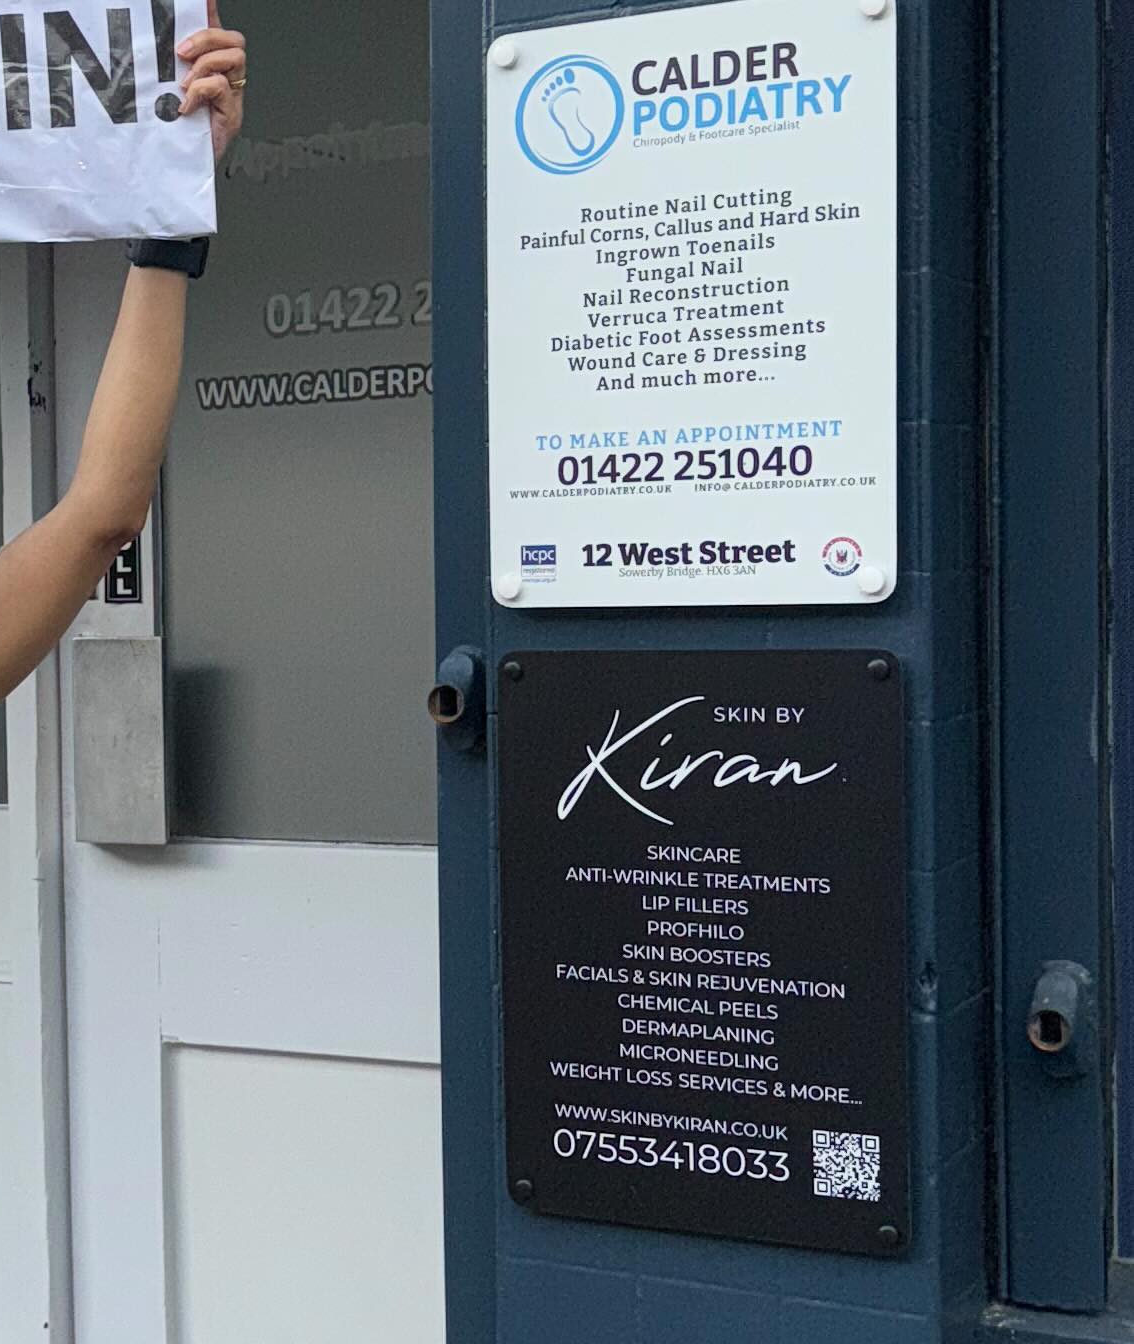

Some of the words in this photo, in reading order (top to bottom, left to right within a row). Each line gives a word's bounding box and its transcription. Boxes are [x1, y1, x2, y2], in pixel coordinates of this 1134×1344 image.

[632, 41, 799, 95] CALDER
[633, 74, 852, 136] PODIATRY
[633, 133, 686, 148] Chiropody
[699, 127, 745, 141] Footcare
[748, 120, 800, 136] Specialist
[581, 202, 659, 223] Routine
[665, 195, 706, 215] Nail
[713, 188, 792, 211] Cutting
[520, 231, 585, 250] Painful
[590, 224, 649, 244] Corns,
[654, 217, 713, 237] Callus
[718, 213, 754, 230] and
[760, 207, 809, 227] Hard
[815, 204, 860, 222] Skin
[596, 245, 680, 266] Ingrown
[687, 234, 775, 256] Toenails
[626, 261, 694, 284] Fungal
[701, 258, 743, 277] Nail
[583, 290, 623, 308] Nail
[629, 277, 789, 304] Reconstruction
[266, 283, 399, 335] 01422
[587, 308, 667, 328] Verruca
[673, 299, 784, 322] Treatment
[551, 332, 632, 353] Diabetic
[639, 329, 681, 346] Foot
[688, 318, 826, 342] Assessments
[568, 352, 635, 372] Wound
[642, 350, 687, 367] Care
[694, 348, 706, 363] &
[713, 342, 806, 364] Dressing
[596, 375, 635, 391] And
[641, 369, 697, 388] much
[704, 366, 775, 385] more...
[536, 435, 562, 451] TO
[569, 431, 628, 449] MAKE
[638, 429, 667, 446] AN
[675, 420, 842, 444] APPOINTMENT
[557, 453, 664, 486] 01422
[673, 444, 813, 482] 251040
[522, 546, 555, 565] hcpc
[582, 543, 612, 567] 12
[618, 542, 693, 567] West
[699, 539, 796, 564] Street
[618, 566, 664, 580] Sowerby
[713, 706, 766, 723] SKIN
[776, 707, 805, 723] BY
[557, 695, 838, 826] Kiran
[646, 845, 742, 864] SKINCARE
[565, 867, 699, 889] ANTI-WRINKLE
[703, 872, 831, 894] TREATMENTS
[642, 895, 670, 911] LIP
[675, 897, 749, 915] FILLERS
[647, 920, 745, 941] PROFHILO
[622, 944, 665, 961] SKIN
[670, 947, 771, 968] BOOSTERS
[556, 964, 629, 984] FACIALS
[632, 969, 645, 984] &
[649, 970, 692, 988] SKIN
[697, 973, 846, 999] REJUVENATION
[617, 993, 714, 1016] CHEMICAL
[719, 1001, 778, 1020] PEELS
[622, 1018, 775, 1045] DERMAPLANING
[619, 1043, 779, 1071] MICRONEEDLING
[550, 1061, 622, 1082] WEIGHT
[626, 1068, 673, 1087] LOSS
[678, 1073, 768, 1096] SERVICES
[772, 1082, 786, 1098] &
[790, 1084, 863, 1105] MORE...
[554, 1103, 788, 1141] WWW.SKINBYKIRAN.CO.UK
[553, 1128, 791, 1182] 07553418033
